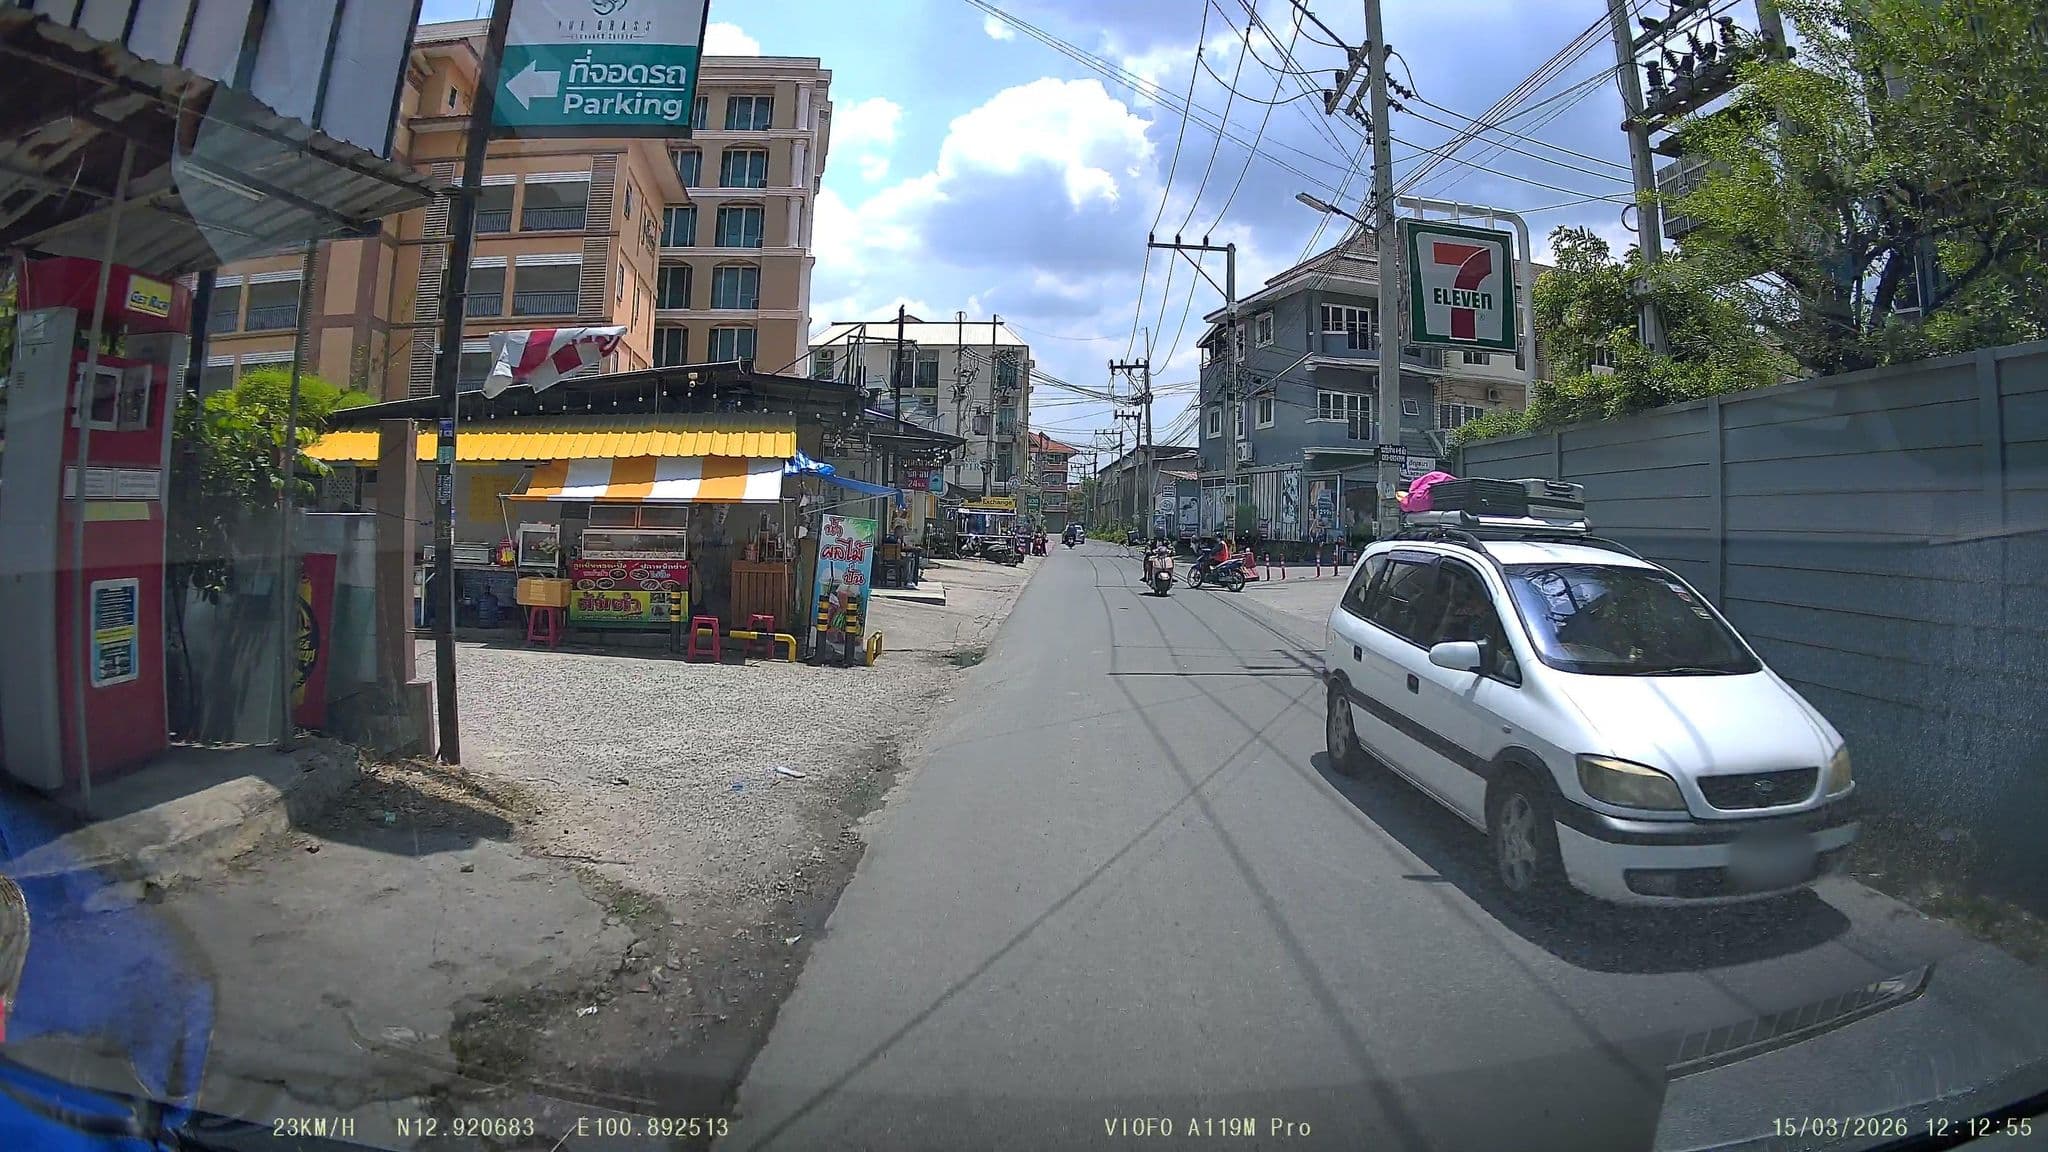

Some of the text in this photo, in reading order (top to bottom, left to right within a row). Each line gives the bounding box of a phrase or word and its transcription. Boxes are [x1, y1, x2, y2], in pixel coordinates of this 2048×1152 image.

[597, 20, 653, 32] GRASS
[568, 49, 687, 85] ที่จอดรถ
[563, 92, 683, 120] Parking
[1432, 241, 1493, 340] 7
[824, 516, 844, 537] น้ำ
[821, 537, 872, 562] ผลไม้
[843, 561, 866, 585] ปั่น
